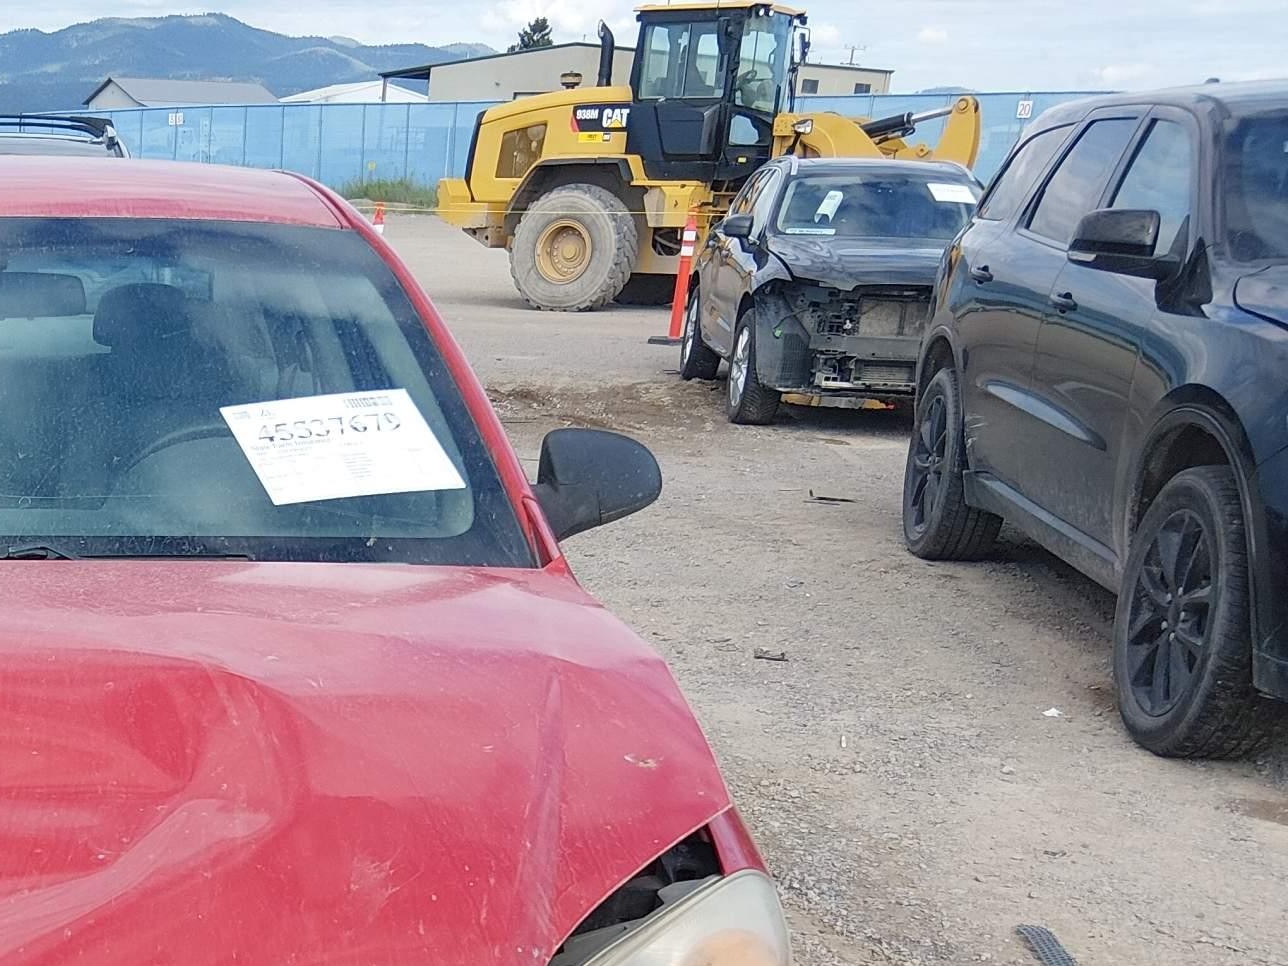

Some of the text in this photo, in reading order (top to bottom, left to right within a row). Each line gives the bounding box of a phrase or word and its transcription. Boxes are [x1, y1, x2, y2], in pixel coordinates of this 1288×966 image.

[1018, 103, 1031, 116] 20
[576, 108, 630, 128] 938M CAT
